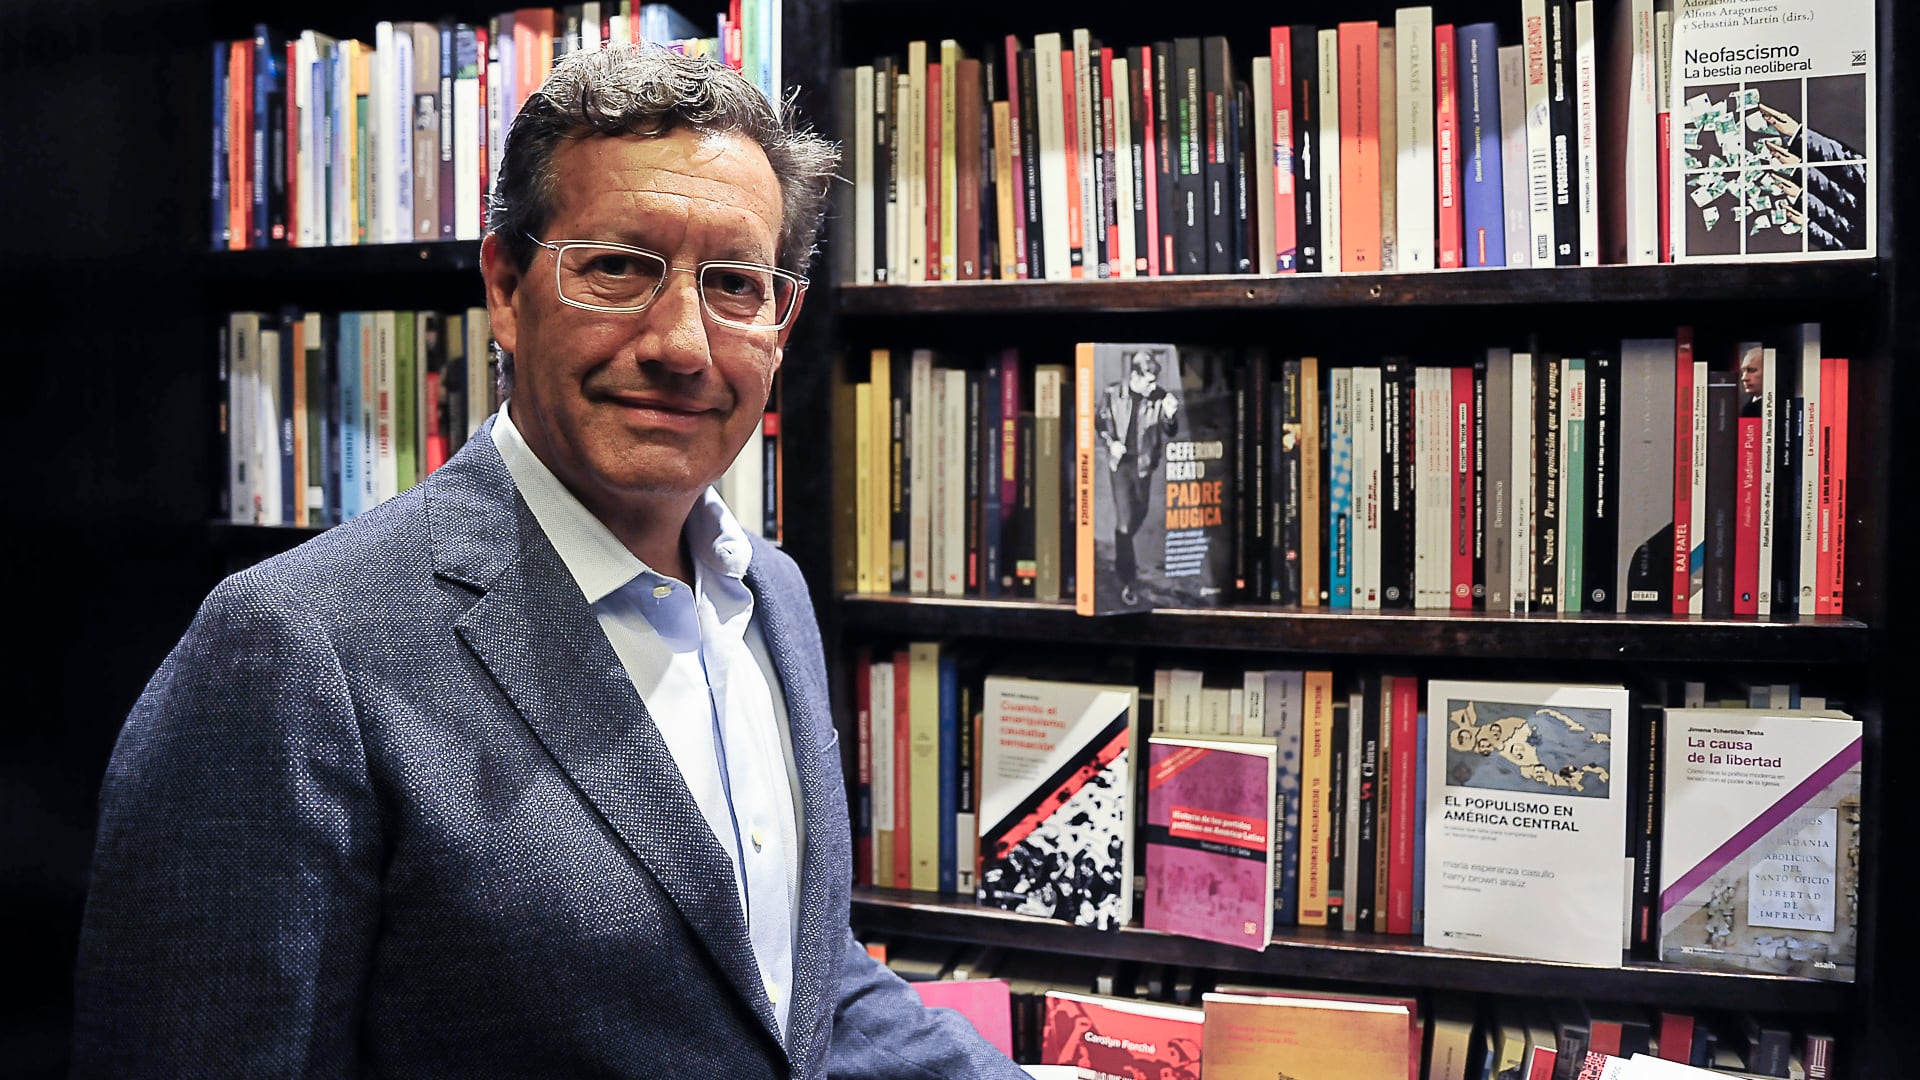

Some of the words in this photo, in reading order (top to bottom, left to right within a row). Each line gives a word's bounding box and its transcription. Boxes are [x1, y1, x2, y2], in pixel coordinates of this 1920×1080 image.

[1683, 10, 1716, 19] Alfons
[1719, 4, 1778, 17] Aragoneses
[1691, 18, 1739, 30] Sebastián
[1782, 10, 1814, 24] (dirs.)
[1685, 44, 1800, 65] Neofascismo
[1684, 68, 1700, 79] La
[1704, 63, 1741, 78] bestia
[1745, 58, 1812, 74] neoliberal
[1548, 400, 1556, 410] se
[1548, 412, 1558, 430] que
[1744, 424, 1754, 448] Putin
[1744, 451, 1754, 488] Vladimir
[1166, 480, 1223, 508] PADRE
[1546, 480, 1554, 498] una
[1494, 481, 1503, 528] Democracia
[1544, 500, 1554, 518] Por
[1677, 524, 1687, 551] PATEL
[1544, 529, 1554, 565] Naredo
[1676, 554, 1686, 572] RAJ
[1001, 701, 1042, 714] Cuando
[1688, 736, 1705, 748] La
[1710, 740, 1752, 750] causa
[1362, 740, 1376, 778] China
[1688, 752, 1705, 763] de
[1710, 753, 1722, 764] la
[1726, 754, 1782, 768] libertad
[1445, 796, 1461, 807] EL
[1465, 798, 1550, 814] POPULISMO
[1554, 806, 1573, 816] EN
[1444, 810, 1508, 826] AMÉRICA
[1512, 816, 1579, 832] CENTRAL
[1783, 864, 1802, 872] DEL
[1468, 875, 1498, 885] brown
[1755, 874, 1788, 883] SANTO
[1794, 875, 1830, 885] OFICIO
[1762, 890, 1821, 900] LIBERTAD
[1760, 911, 1822, 922] IMPRENTA
[1085, 1032, 1120, 1049] Carolyn
